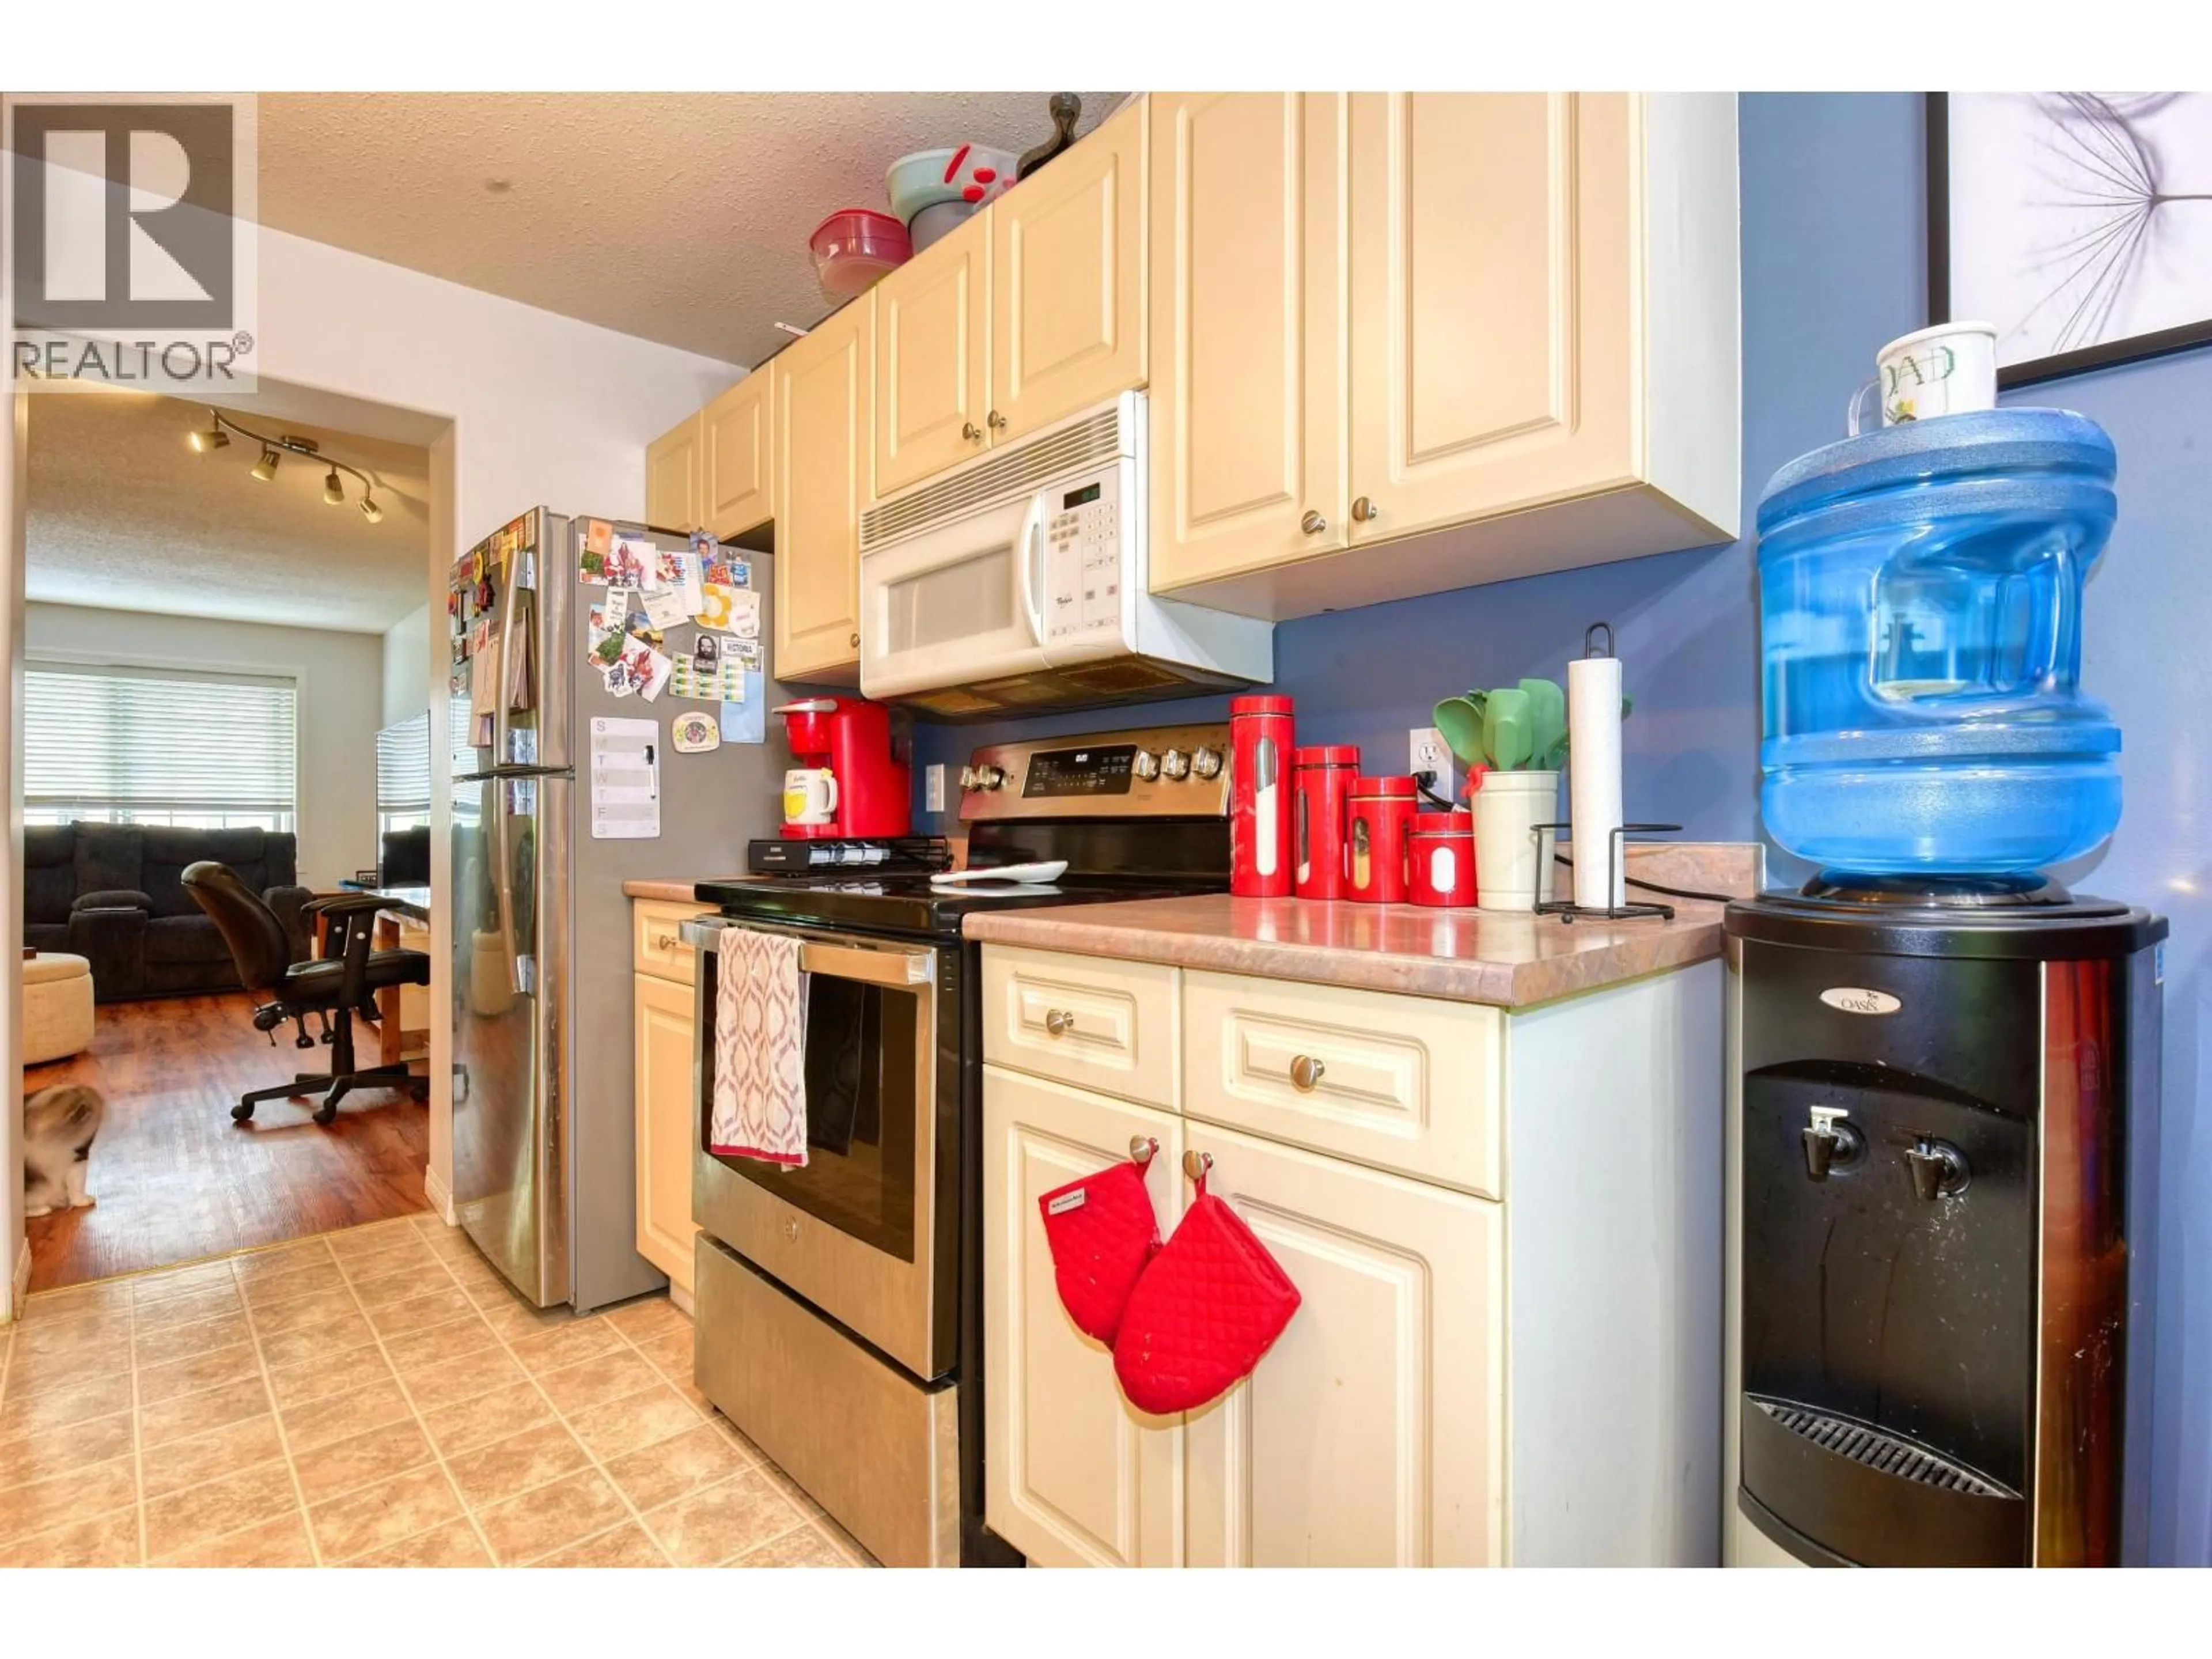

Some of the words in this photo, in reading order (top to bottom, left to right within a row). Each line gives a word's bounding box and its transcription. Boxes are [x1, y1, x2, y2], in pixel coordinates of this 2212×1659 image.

[596, 720, 606, 732] S
[597, 754, 607, 767] T
[597, 806, 607, 819] F
[1841, 997, 1879, 1012] OASIS
